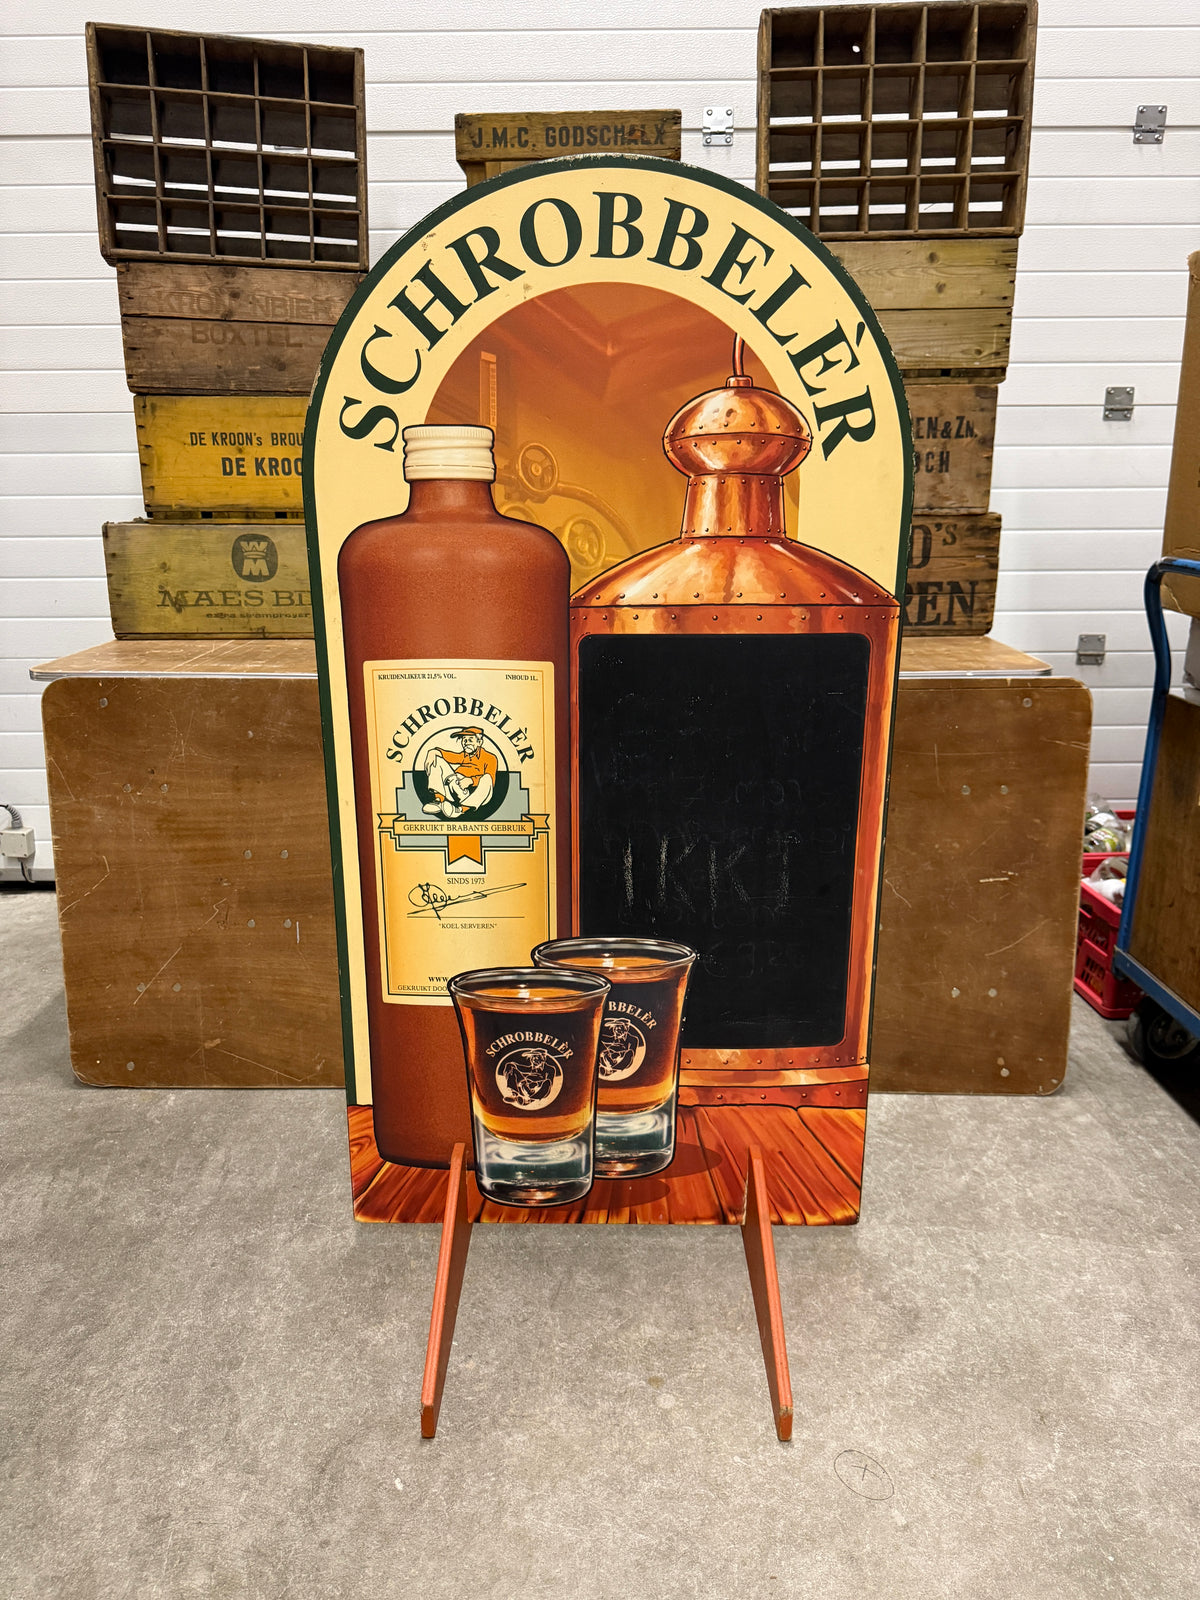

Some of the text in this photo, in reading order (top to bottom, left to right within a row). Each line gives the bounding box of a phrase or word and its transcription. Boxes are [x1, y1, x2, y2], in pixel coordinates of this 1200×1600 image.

[472, 127, 537, 149] J.M.C.
[191, 322, 303, 348] BOXTEL
[338, 191, 877, 461] SCHROBBELÈR
[190, 432, 207, 446] DE
[221, 457, 247, 476] DE
[156, 590, 265, 609] MAES
[386, 696, 535, 764] SCHROBBELÈR
[403, 824, 527, 832] GEKRUIKT BRABANTS GEBRUIK
[447, 877, 486, 885] SINDS 1973
[485, 1031, 574, 1060] SCHROBBELÈR
